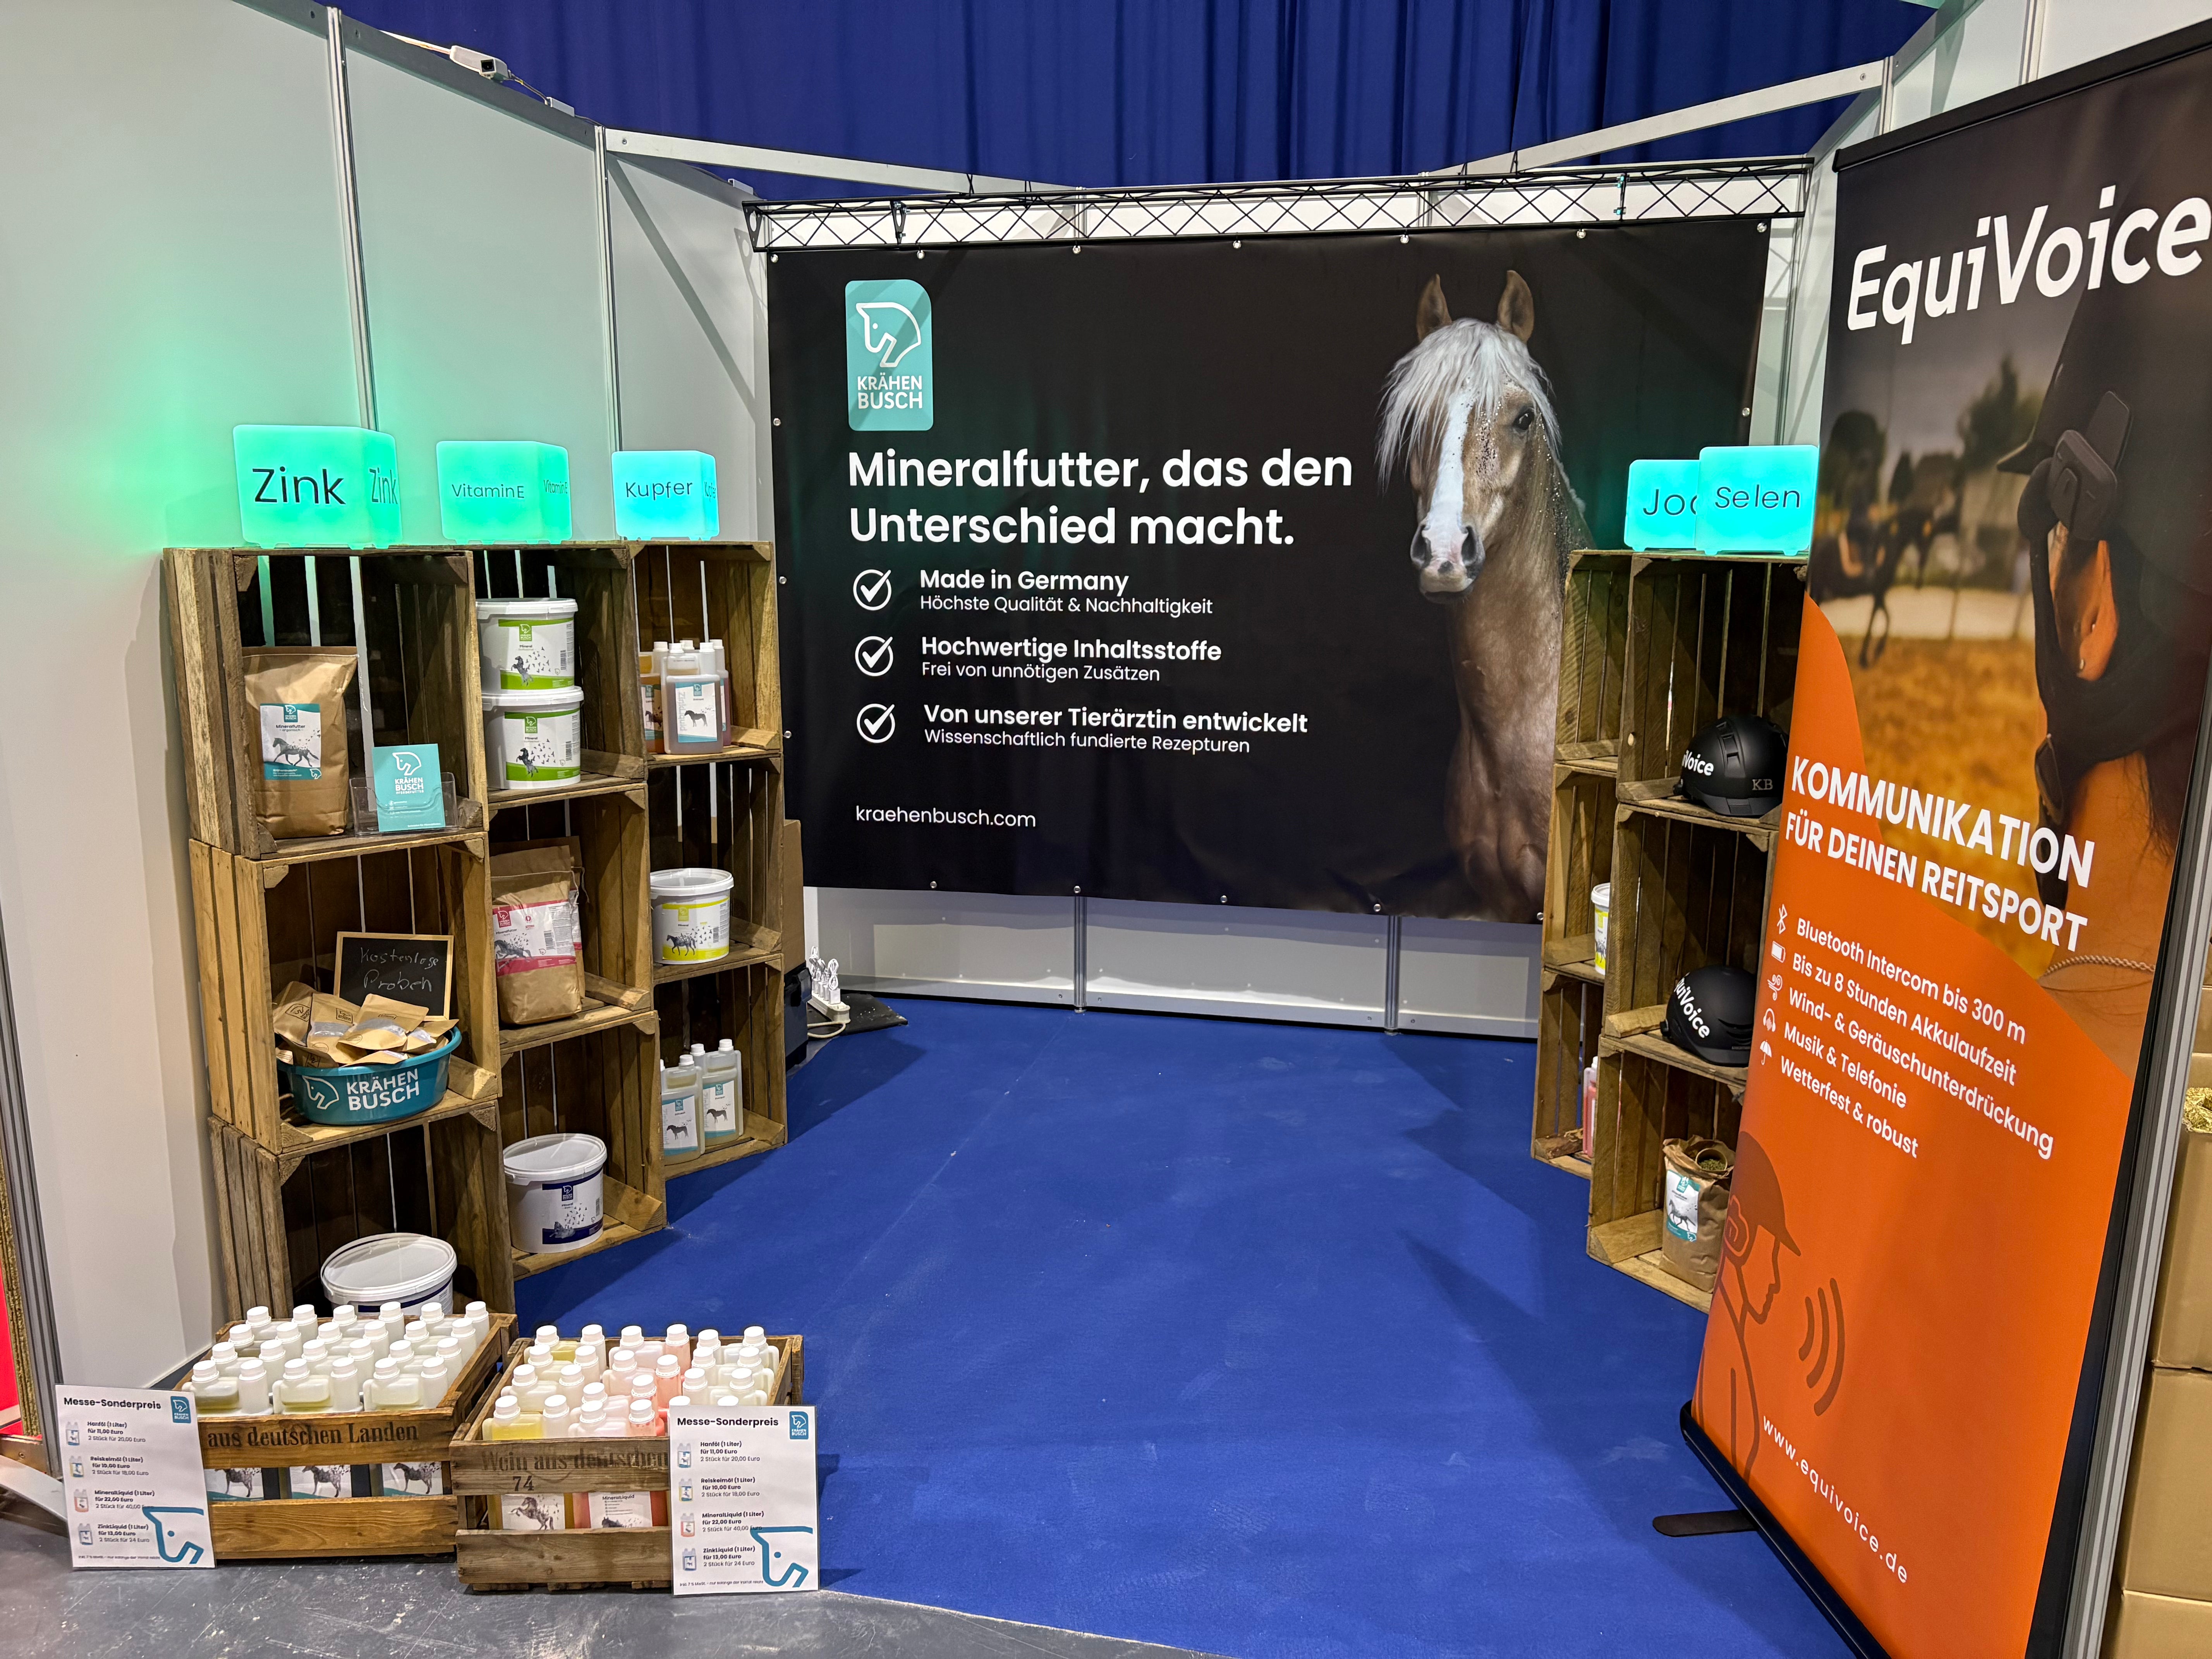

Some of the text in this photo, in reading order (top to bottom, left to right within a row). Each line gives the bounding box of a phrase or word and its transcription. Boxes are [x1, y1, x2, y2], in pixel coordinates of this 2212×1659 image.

[1848, 185, 2211, 344] EquiVoice
[858, 373, 922, 390] KRÄHEN
[858, 392, 922, 409] BUSCH
[850, 448, 1351, 493] Mineralfutter, das den
[252, 467, 346, 504] Zink
[369, 467, 398, 505] Zink
[626, 482, 692, 500] Kupfer
[1715, 484, 1800, 508] Selen
[851, 505, 1293, 544] Unterschied macht.
[921, 569, 1129, 596] Made in Germany
[921, 595, 1212, 618] Höchste Qualität & Nachhaltigkeit
[922, 637, 1221, 664] Hochwertige Inhaltsstoffe
[923, 661, 1159, 683] Frei von unnötigen Zusätzen
[924, 705, 1307, 732] Von unserer Tierärztin entwickelt
[925, 729, 1249, 755] Wissenschaftlich fundierte Rezepturen
[395, 783, 424, 791] BUSCH
[1752, 779, 1773, 790] KB
[857, 805, 1035, 827] kraehenbusch.com
[1792, 756, 2095, 888] KOMMUNIKATION
[1786, 812, 2088, 951] FÜR DEINEN REITSPORT
[360, 947, 439, 969] Kostenlose
[363, 970, 432, 992] Proben
[1797, 918, 2025, 1044] Bluetooth Intercom bis 300 m
[1674, 972, 1710, 1038] quiVoice
[1793, 953, 2016, 1085] Bis zu 8 Stunden Akkulaufzeit
[1784, 1022, 1906, 1108] Musik & Telefonie
[1790, 988, 2053, 1159] Wind- & Geräuschunterdrückung
[347, 1069, 418, 1094] KRÄHEN
[349, 1081, 419, 1110] BUSCH
[1781, 1056, 1918, 1158] Wetterfest & robust
[64, 1397, 161, 1410] Messe-Sonderpreis
[208, 1422, 419, 1448] aus deutschen Landen
[677, 1417, 778, 1427] Messe-Sonderpreis
[481, 1451, 527, 1471] Wein
[534, 1455, 567, 1470] aus
[513, 1475, 534, 1491] 74
[1764, 1416, 1906, 1583] www.equivoice.de
